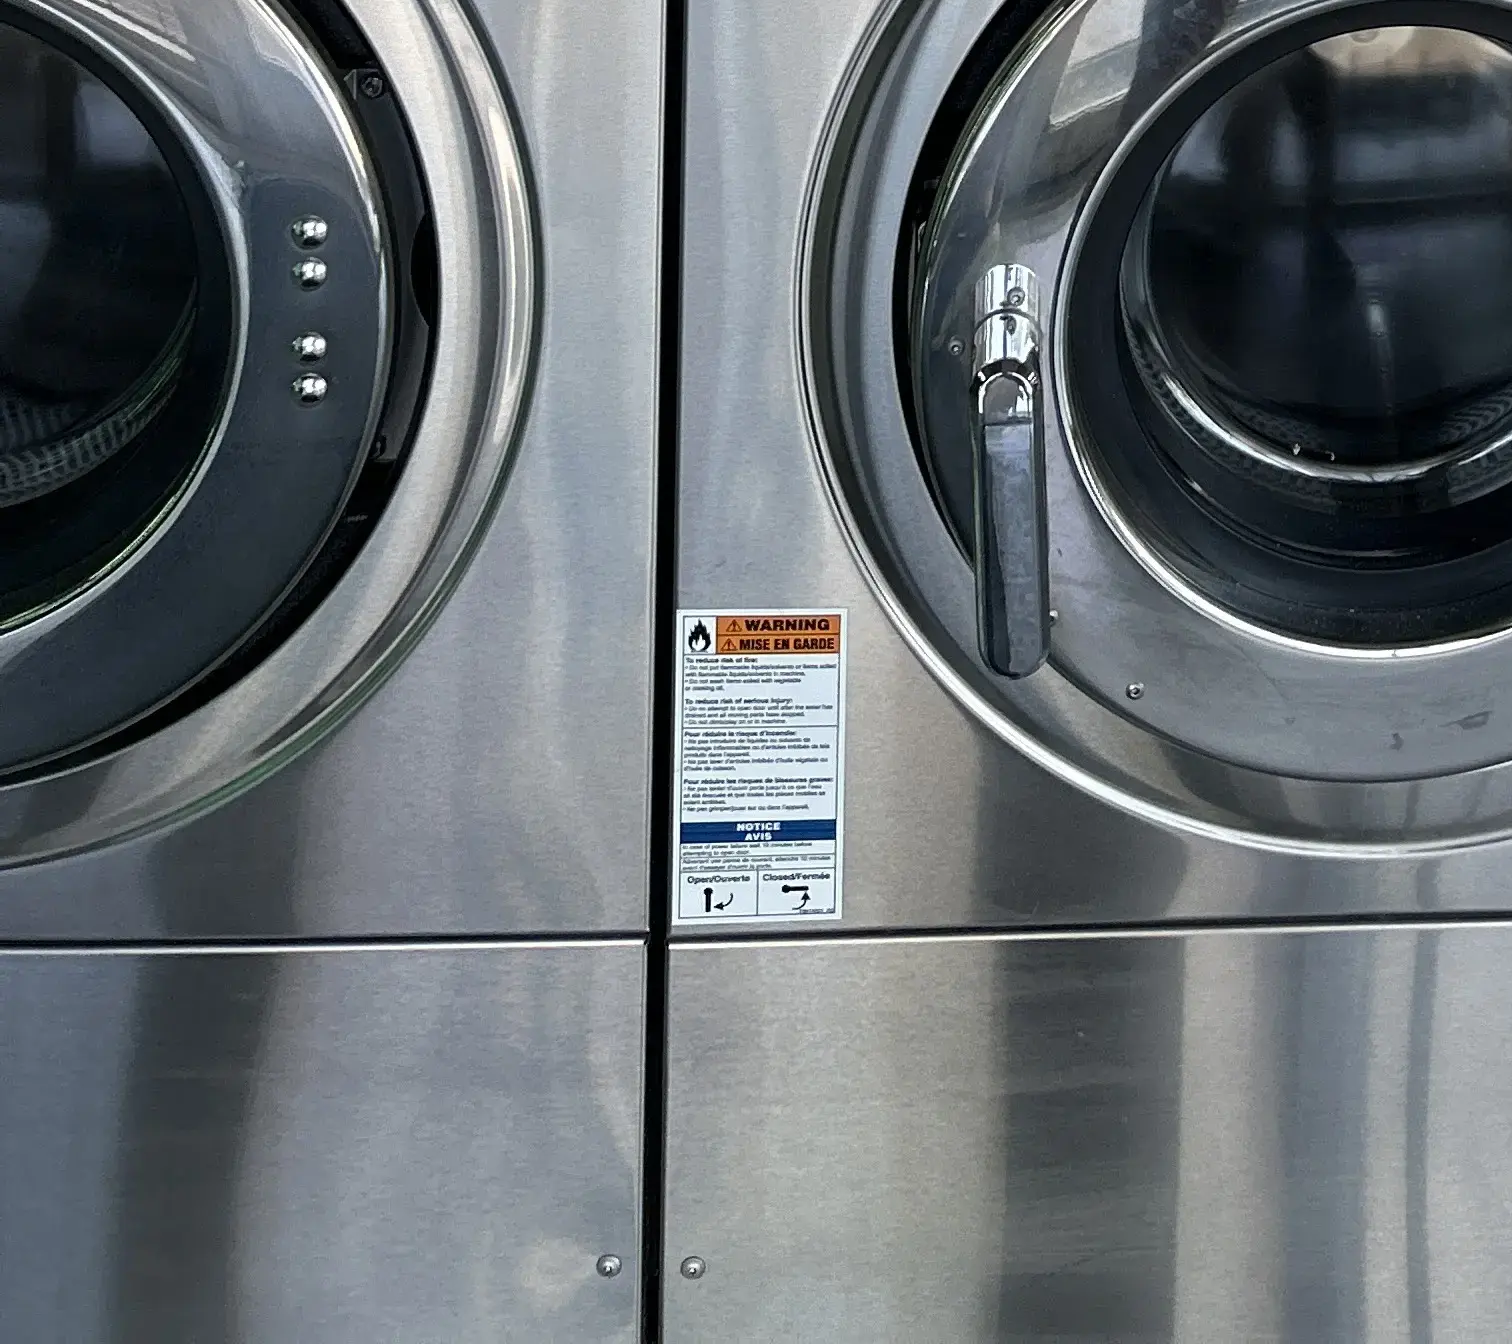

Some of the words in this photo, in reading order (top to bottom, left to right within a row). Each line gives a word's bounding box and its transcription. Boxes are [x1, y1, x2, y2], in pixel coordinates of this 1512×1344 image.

[744, 618, 830, 631] WARNING
[739, 639, 770, 651] MISE
[773, 638, 790, 650] EN
[793, 637, 835, 650] GARDE
[736, 822, 781, 831] NOTICE
[744, 832, 773, 841] AVIS
[687, 874, 751, 885] Open/Ouverte
